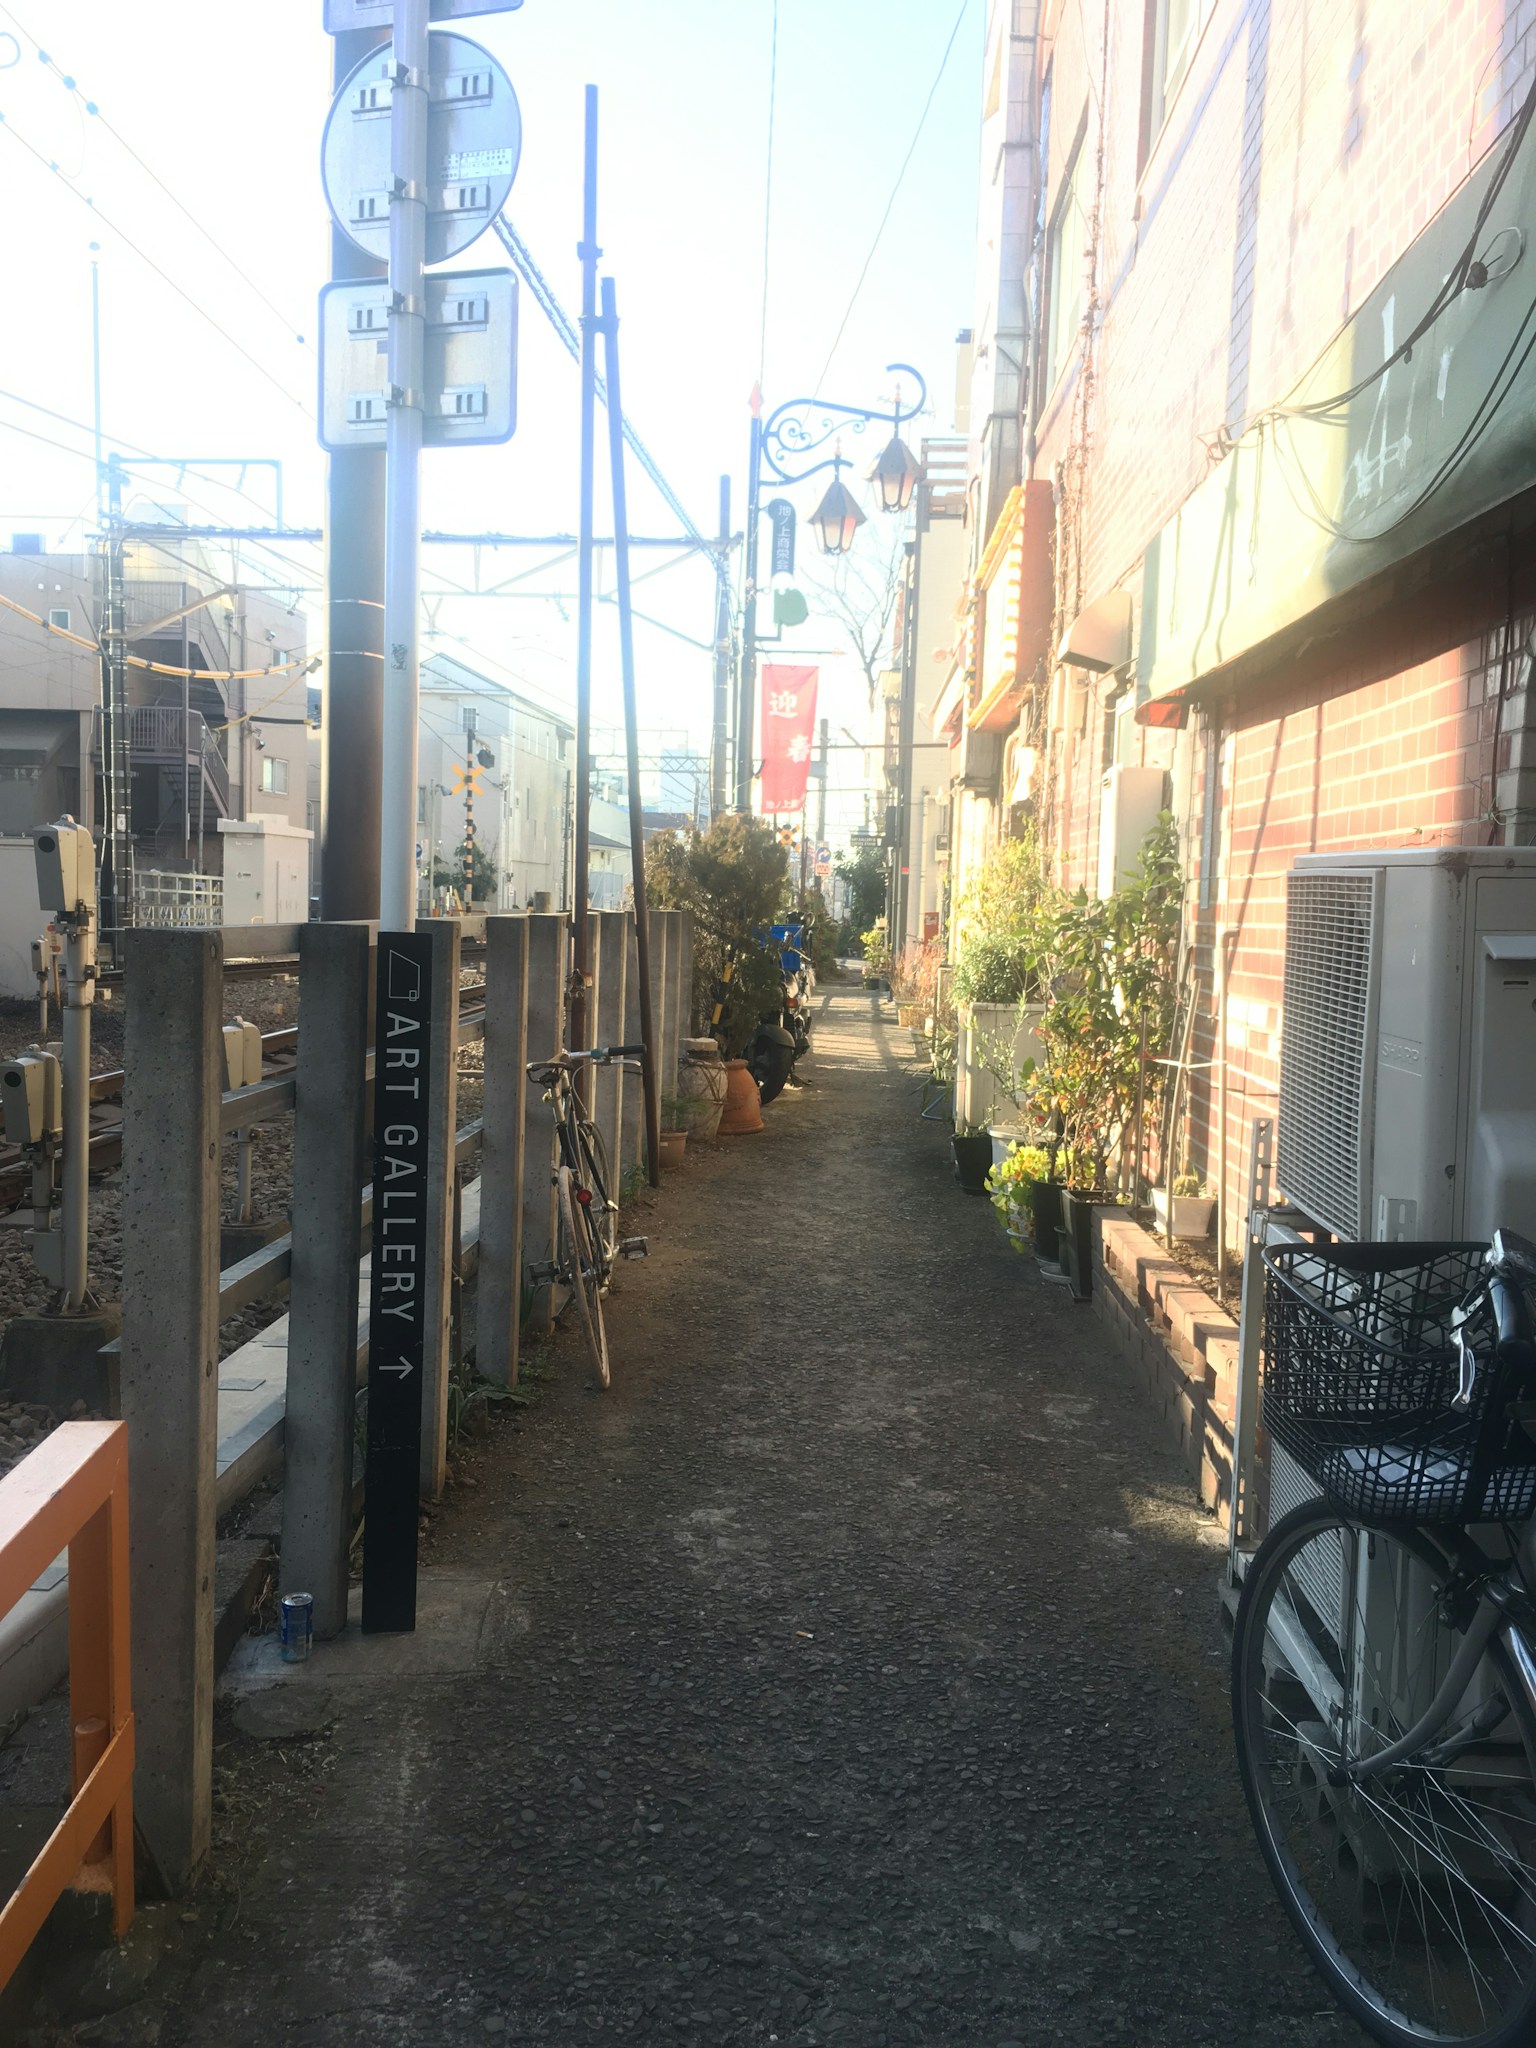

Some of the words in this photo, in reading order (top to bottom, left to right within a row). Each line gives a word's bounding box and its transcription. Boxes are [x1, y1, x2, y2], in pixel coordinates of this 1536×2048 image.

[776, 505, 792, 570] 池ノ上商栄会
[385, 1011, 420, 1099] ART
[380, 1124, 419, 1322] GALLERY
